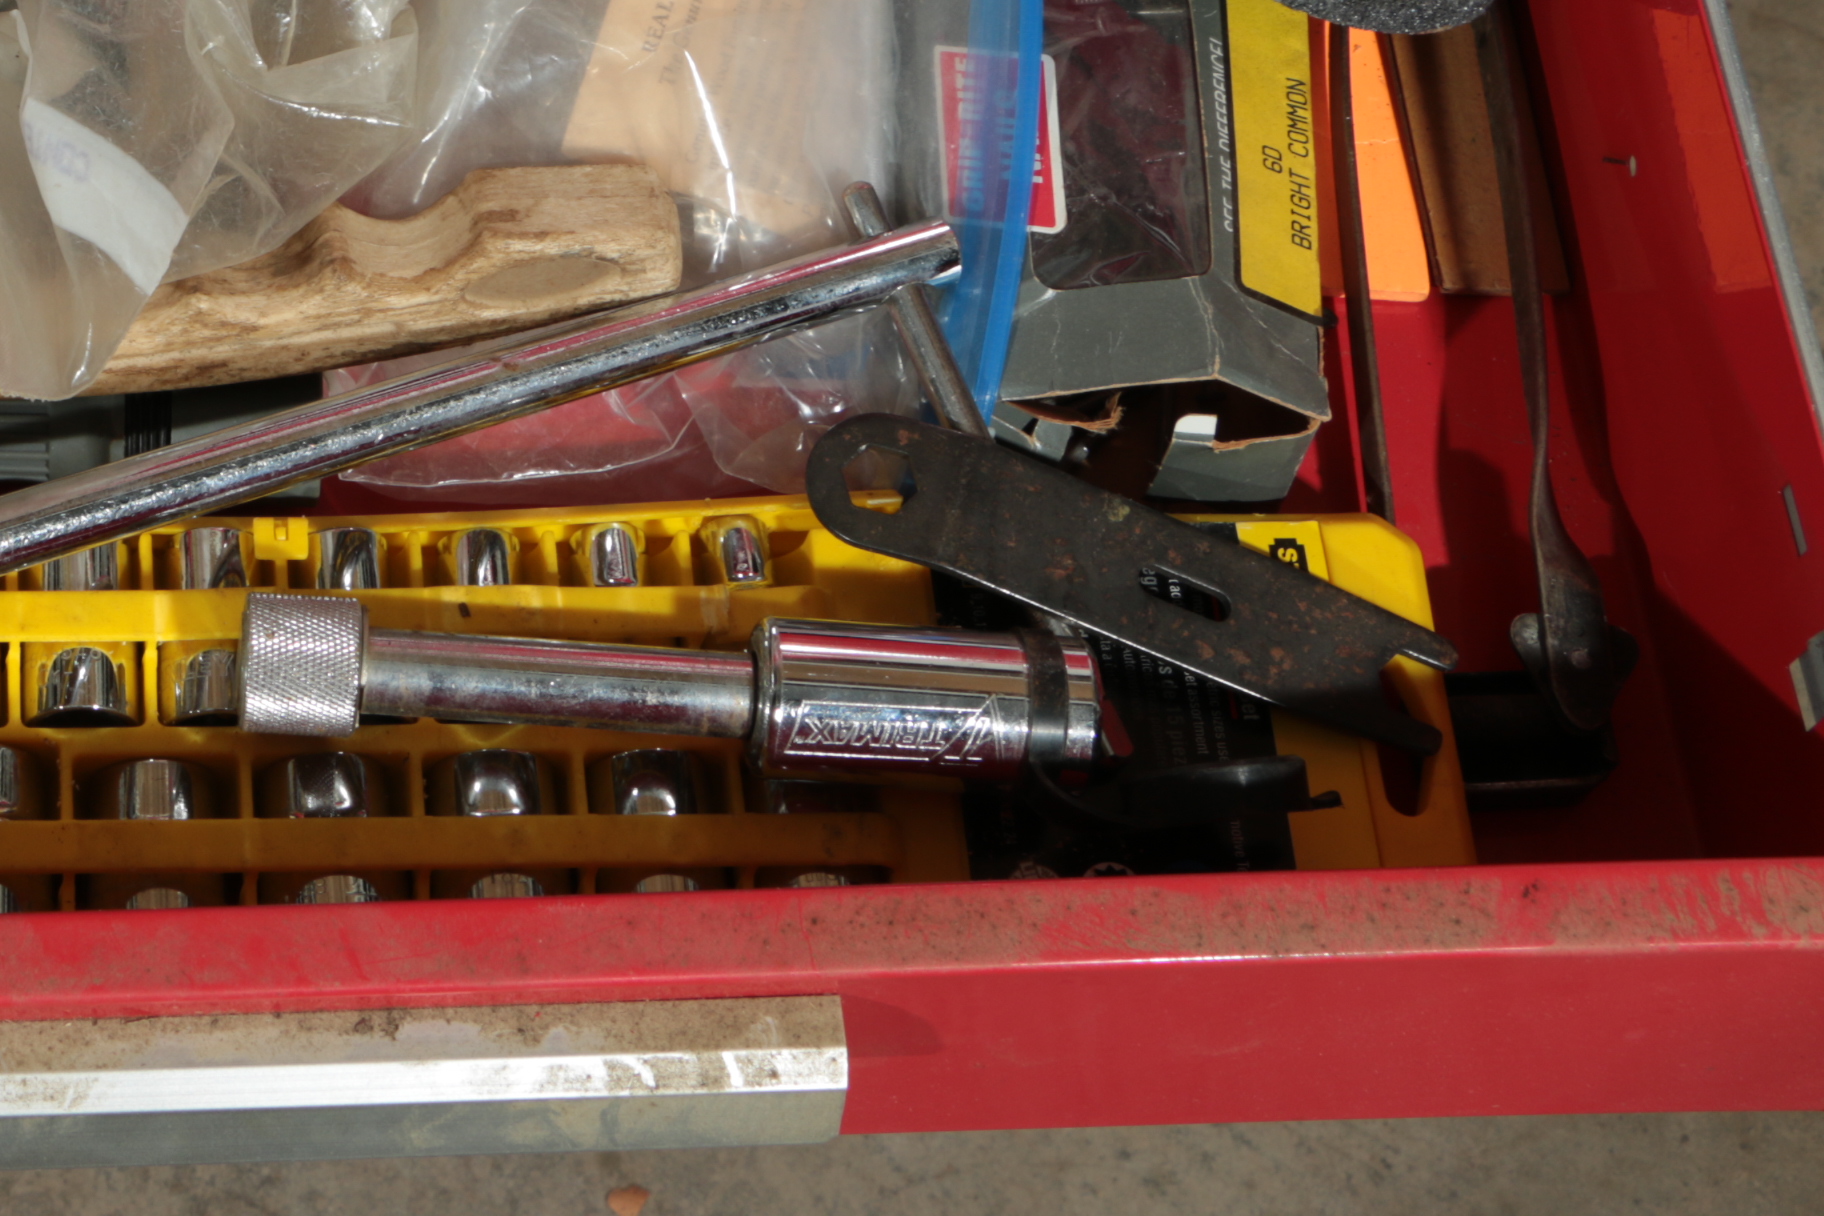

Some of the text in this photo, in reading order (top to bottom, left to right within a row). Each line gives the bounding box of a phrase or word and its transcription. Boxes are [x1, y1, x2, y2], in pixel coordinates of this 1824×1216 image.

[1261, 143, 1283, 174] 6D
[1283, 76, 1314, 251] BRIGHT COMMON
[802, 713, 946, 752] TRIMAX
